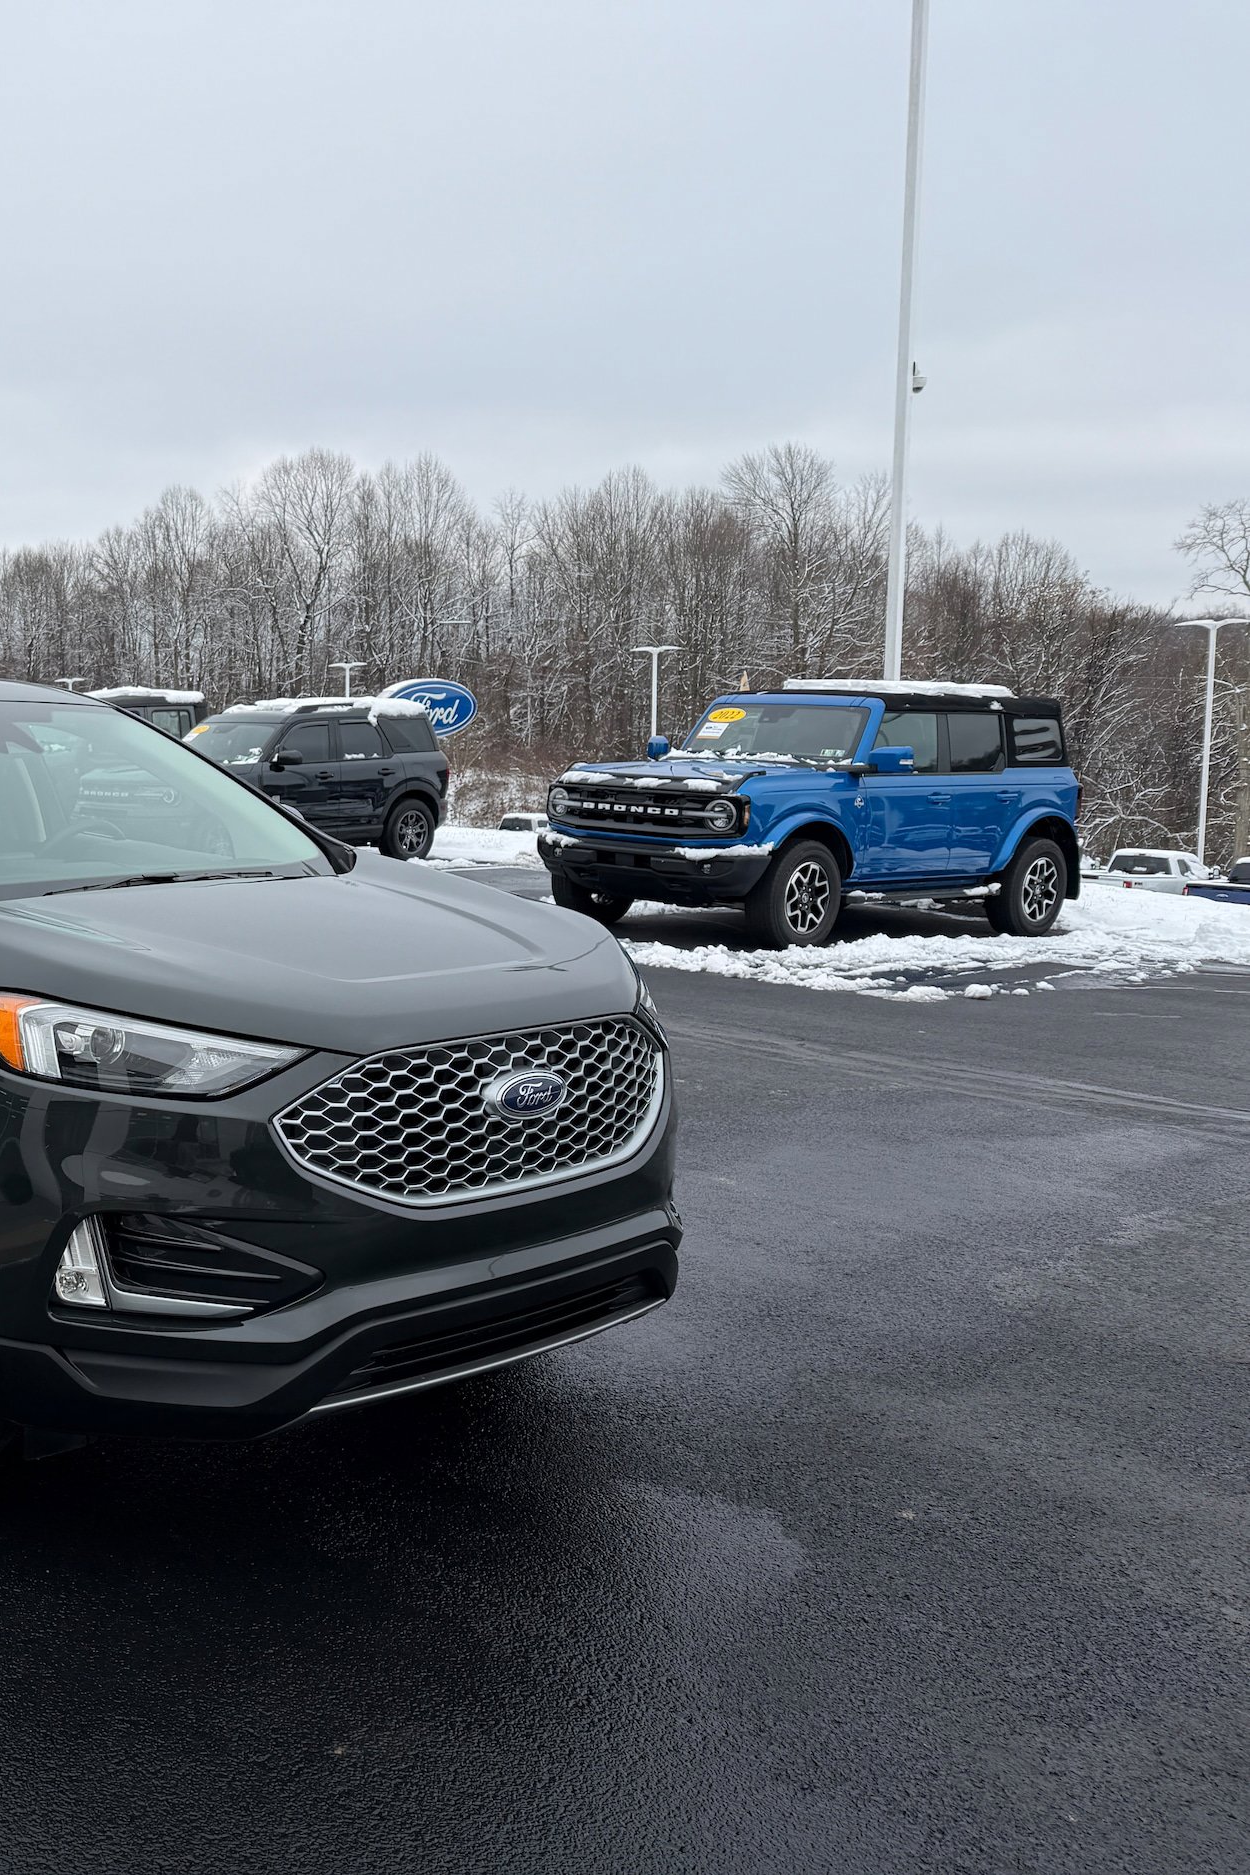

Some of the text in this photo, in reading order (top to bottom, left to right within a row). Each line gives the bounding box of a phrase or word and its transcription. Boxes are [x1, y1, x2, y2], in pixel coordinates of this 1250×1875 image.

[410, 692, 460, 725] Frd
[582, 801, 680, 816] BRONCO
[516, 1081, 554, 1108] Ford
